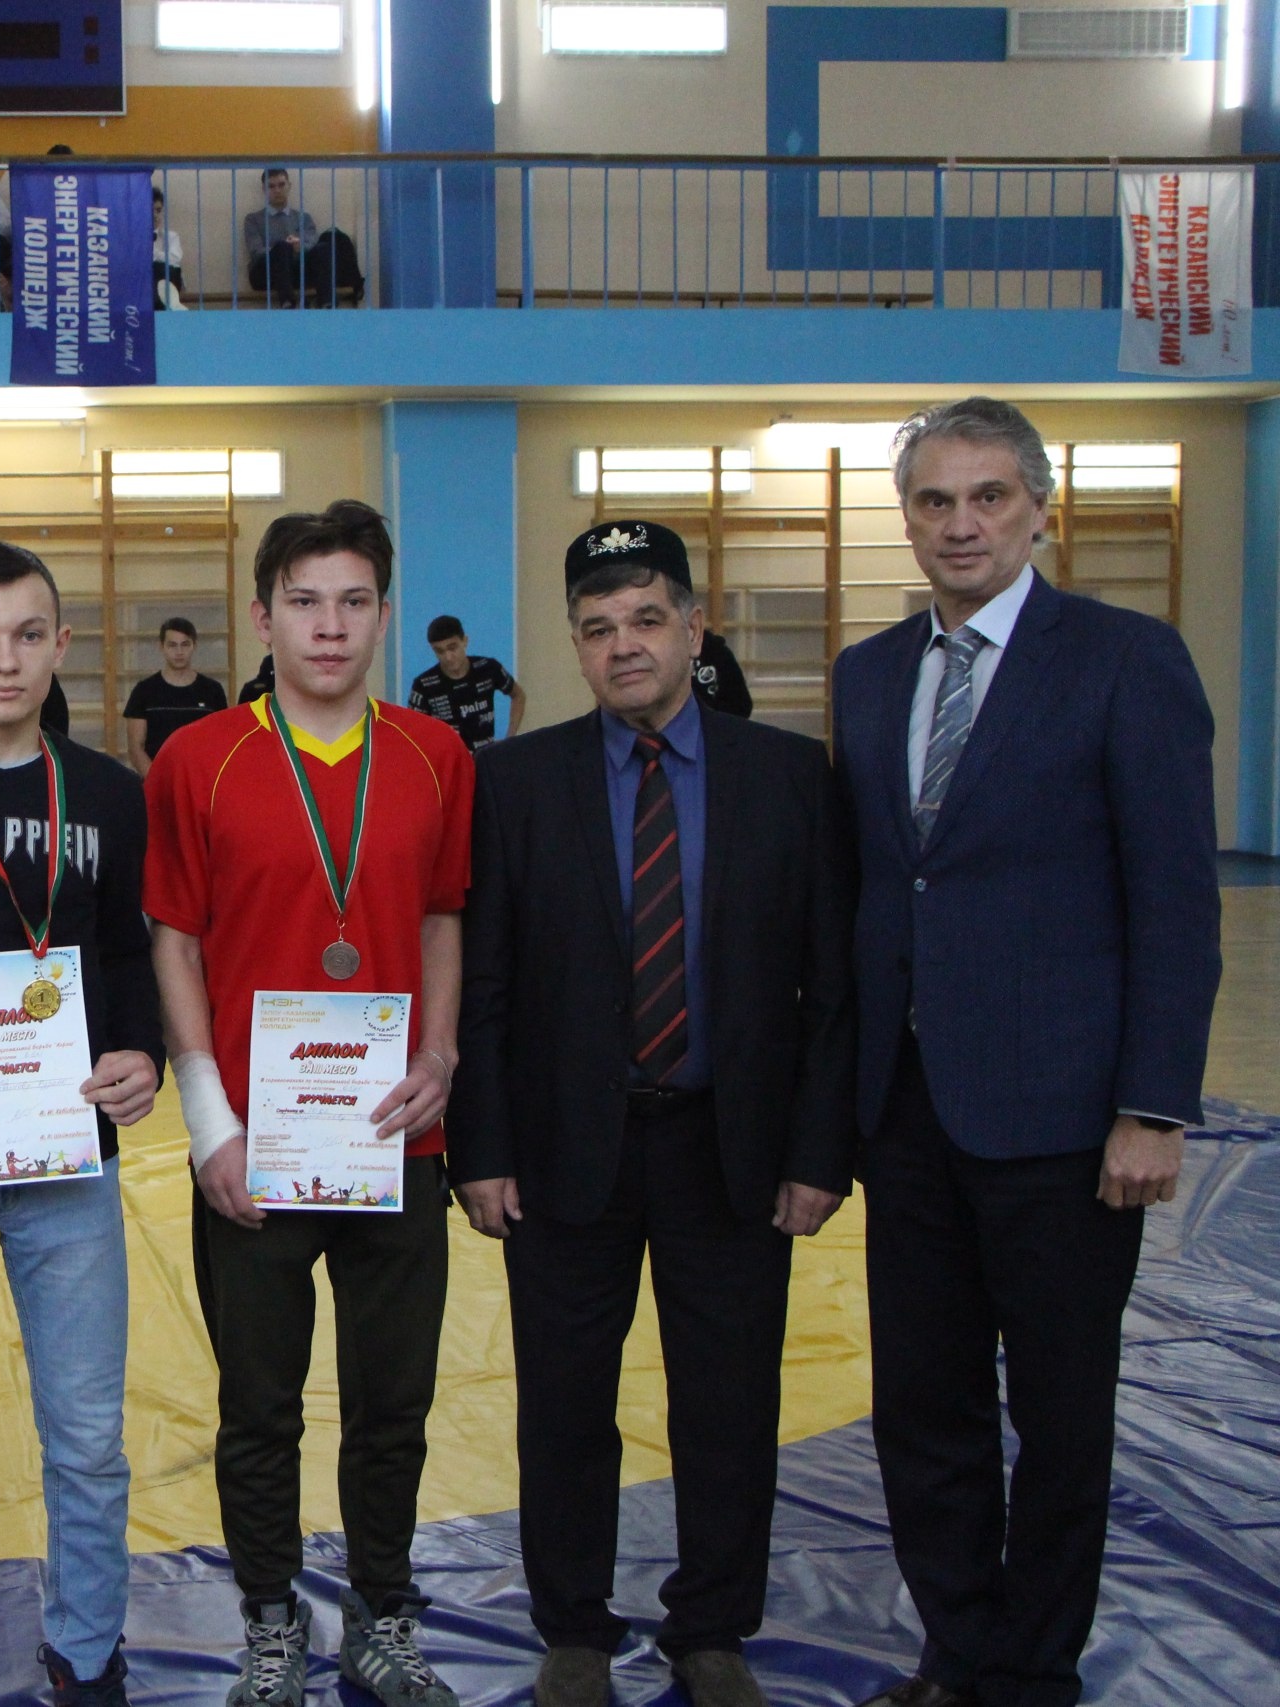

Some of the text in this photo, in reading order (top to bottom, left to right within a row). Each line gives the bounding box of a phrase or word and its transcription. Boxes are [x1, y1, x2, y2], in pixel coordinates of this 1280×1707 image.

[21, 217, 48, 331] КОЛЛЕДЖ
[54, 175, 84, 375] ЭНЕРГЕТИЧЕСКИЙ
[86, 207, 115, 343] КАЗАНСКИЙ
[1157, 174, 1186, 366] ЭНЕРГЕТИЧЕСКИЙ
[1186, 206, 1214, 335] КАЗАНСКИЙ
[1, 1030, 37, 1042] МЕСТО
[289, 1041, 369, 1060] ДИПЛОМ
[323, 1064, 358, 1075] МЕСТО
[296, 1093, 358, 1106] ВРУЧАЕТСЯ
